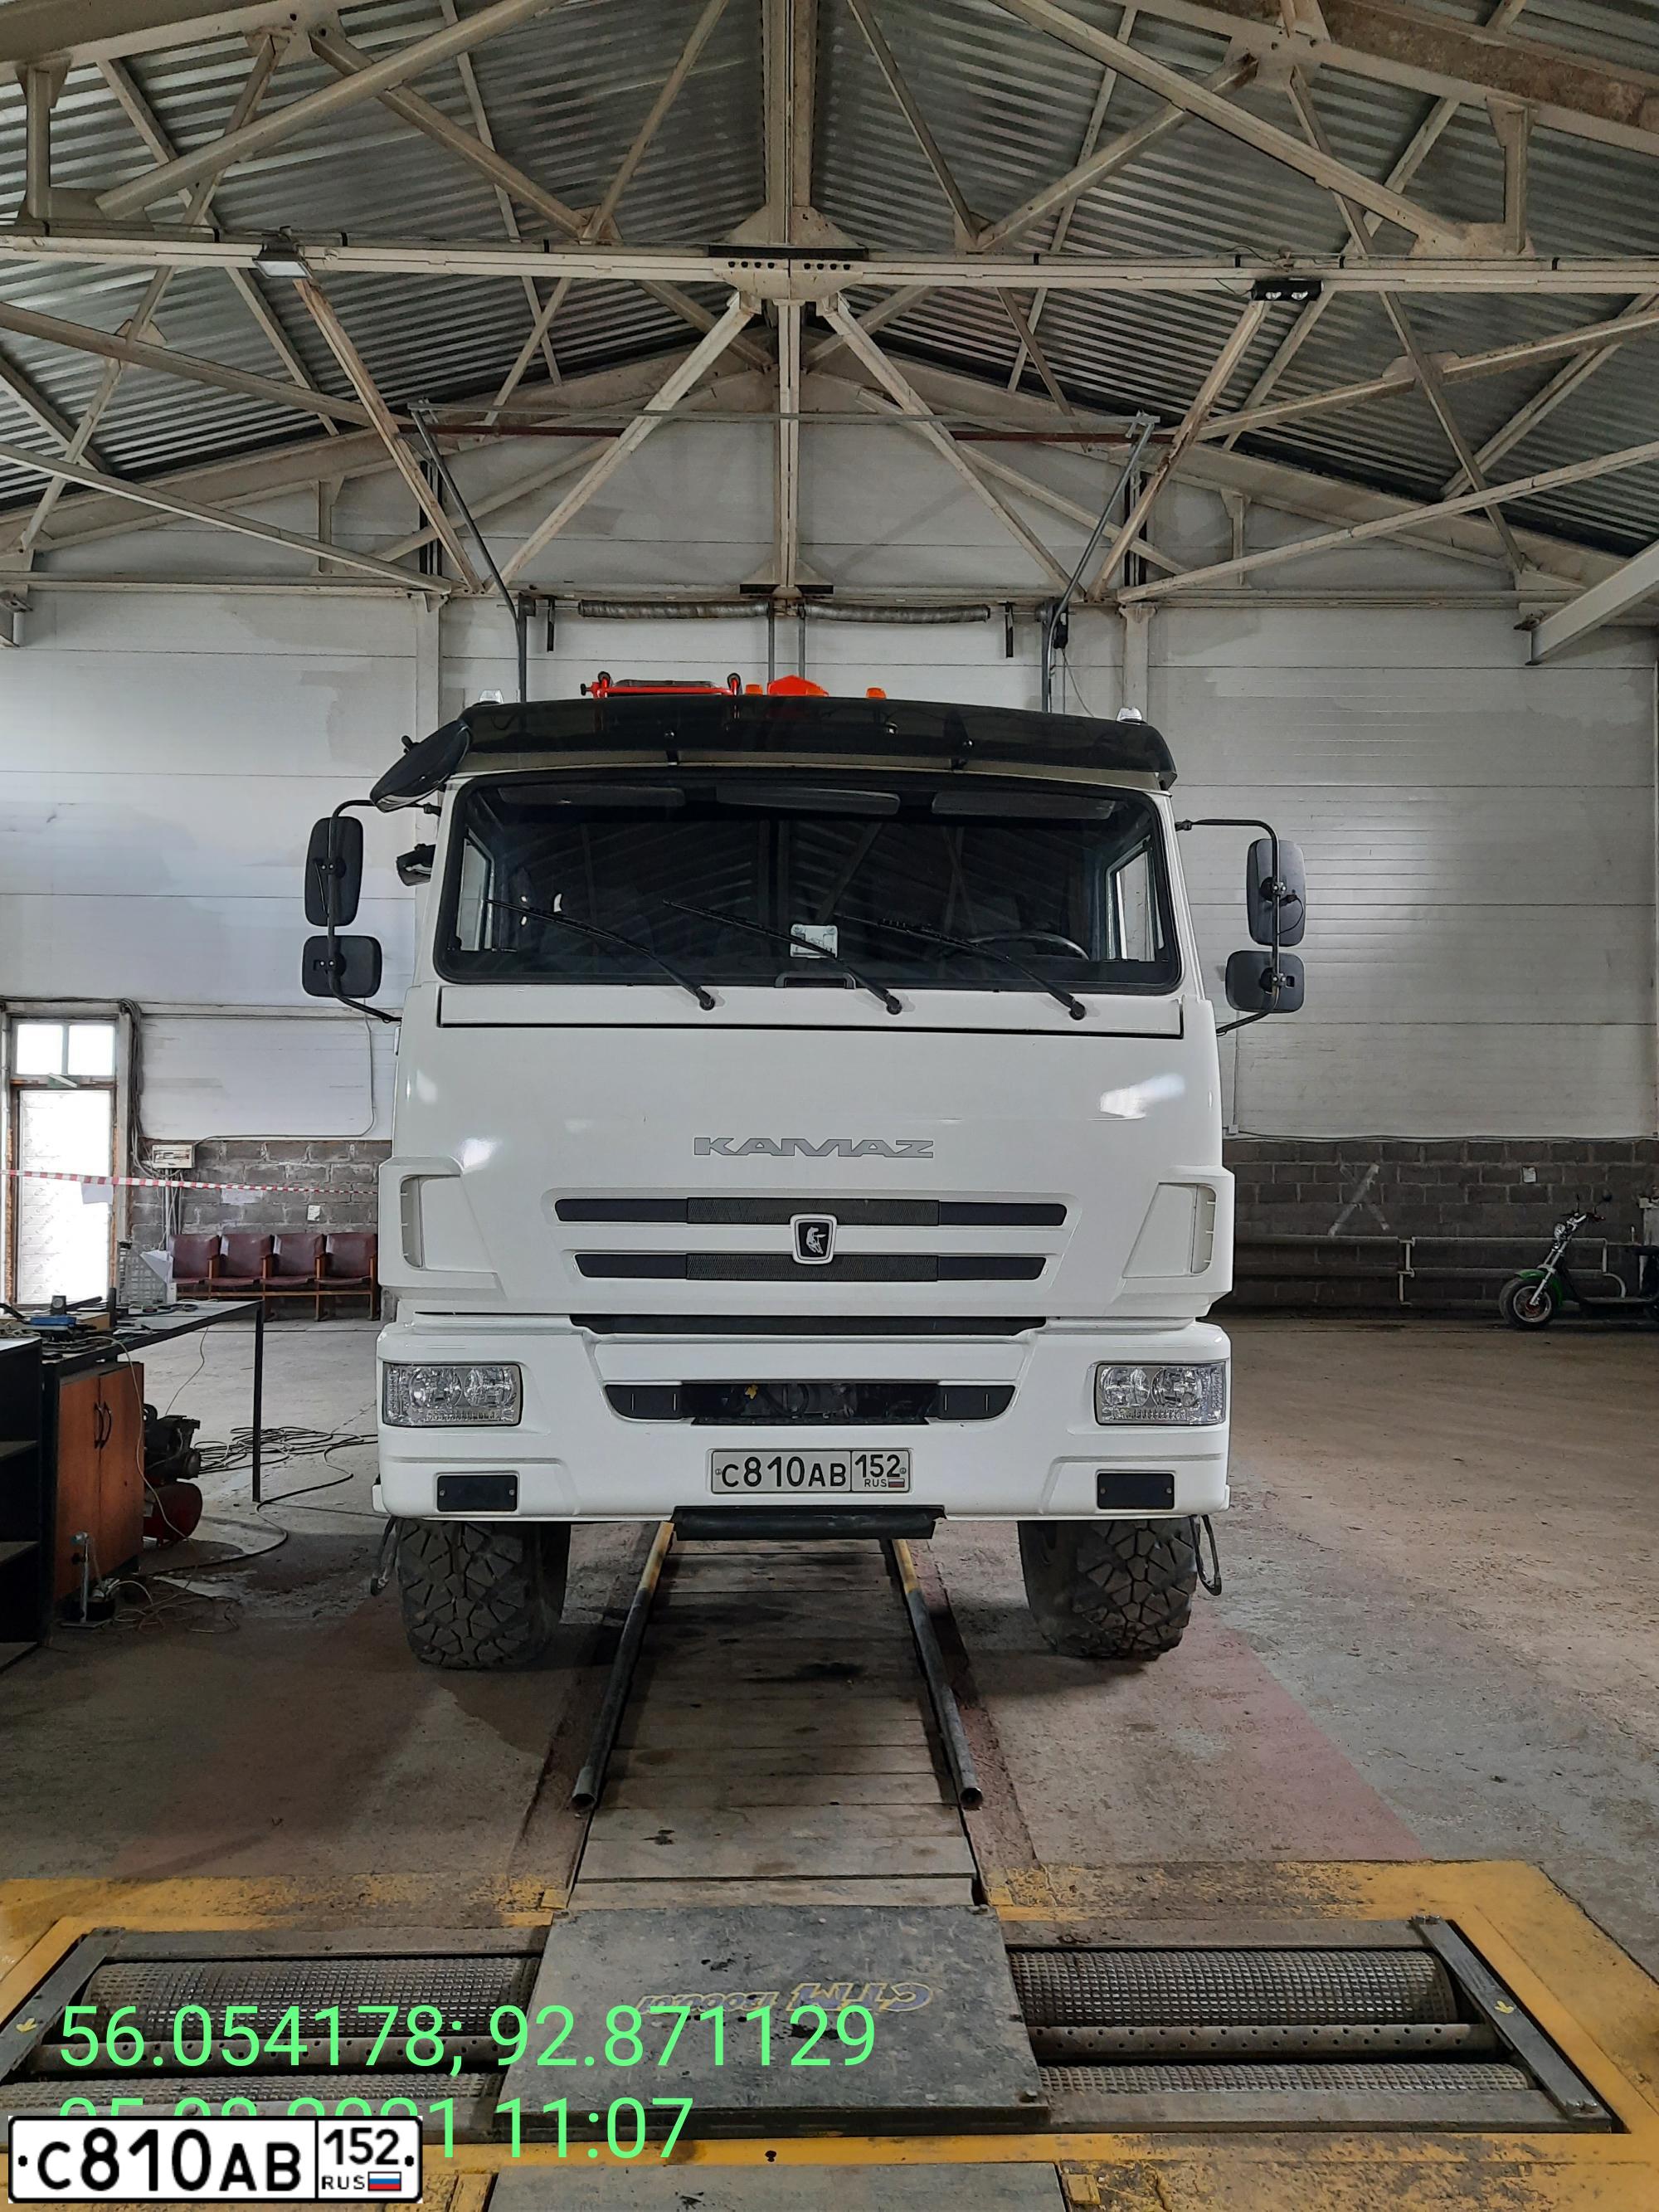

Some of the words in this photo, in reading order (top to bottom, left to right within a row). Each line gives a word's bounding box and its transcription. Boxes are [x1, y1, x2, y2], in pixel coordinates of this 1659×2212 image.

[693, 1137, 934, 1158] KAMAZ
[854, 1454, 901, 1479] 152
[864, 1479, 888, 1488] RUS
